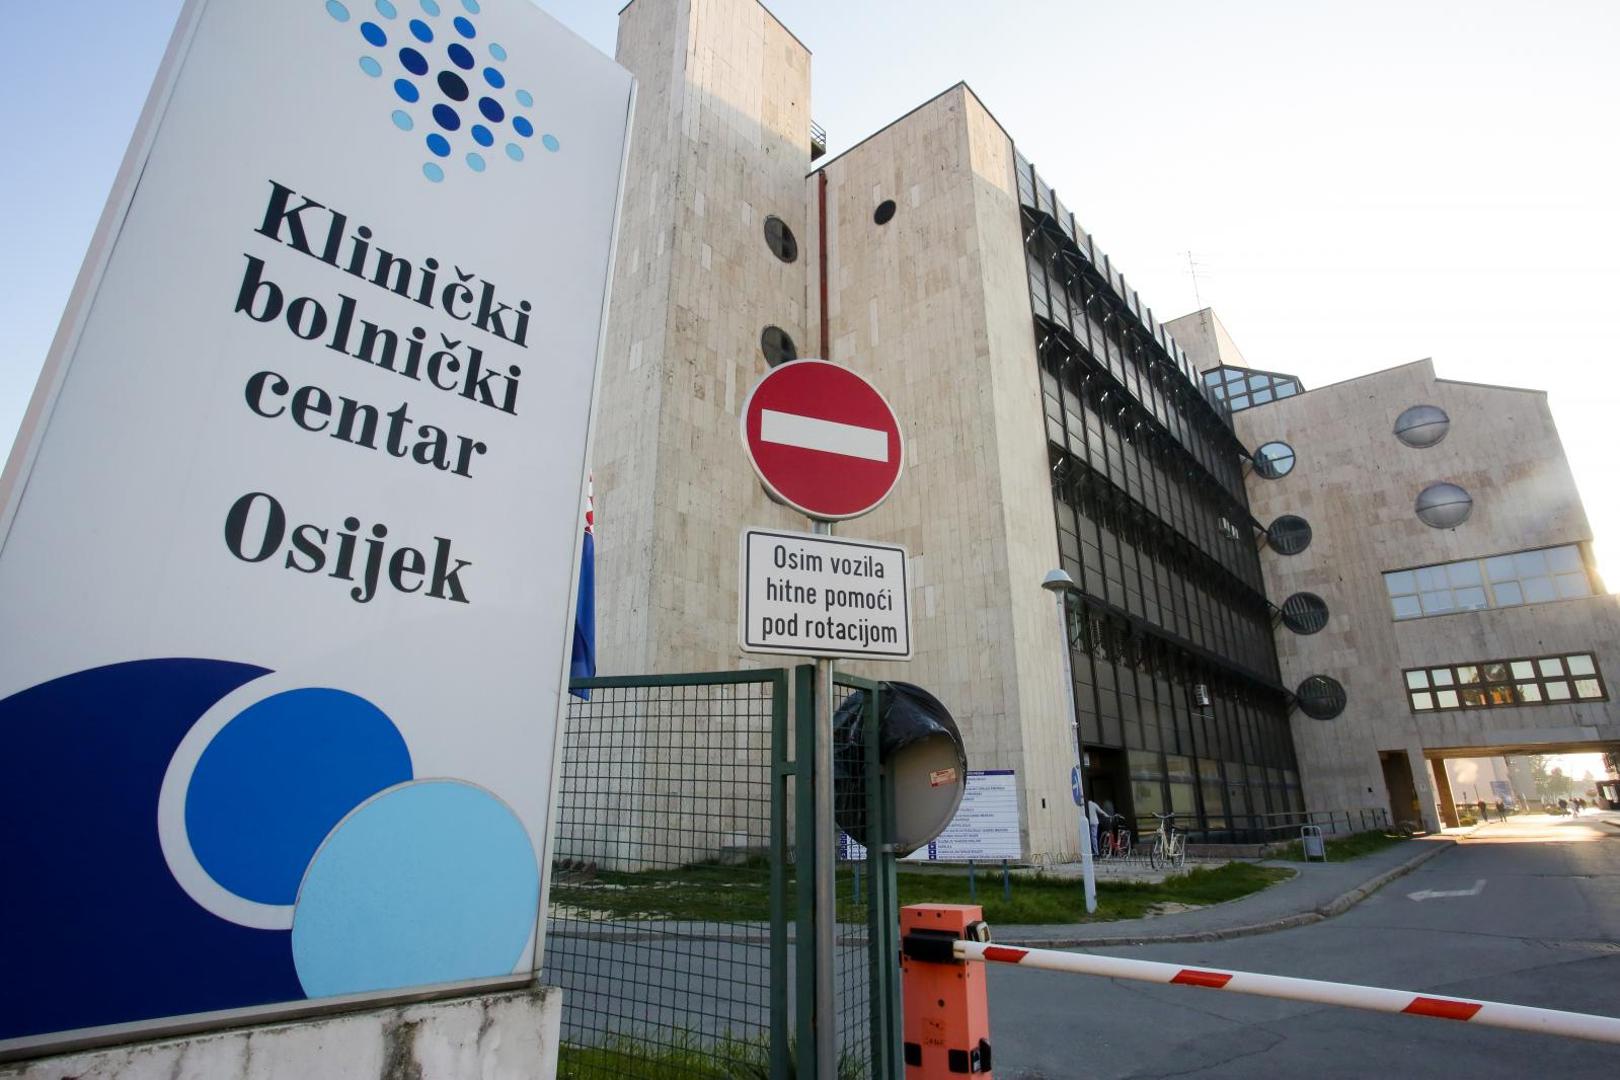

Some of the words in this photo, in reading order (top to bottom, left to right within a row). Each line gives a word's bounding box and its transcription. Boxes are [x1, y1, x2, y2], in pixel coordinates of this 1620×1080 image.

[254, 179, 532, 349] Klinički
[234, 253, 522, 416] bolnički
[244, 370, 487, 479] centar
[224, 491, 473, 604] Osijek
[766, 576, 817, 605] hitne
[825, 588, 893, 613] pomoći
[774, 544, 823, 573] Osim
[830, 555, 885, 579] vozila
[762, 612, 798, 641] pod
[805, 616, 898, 648] rotacijom
